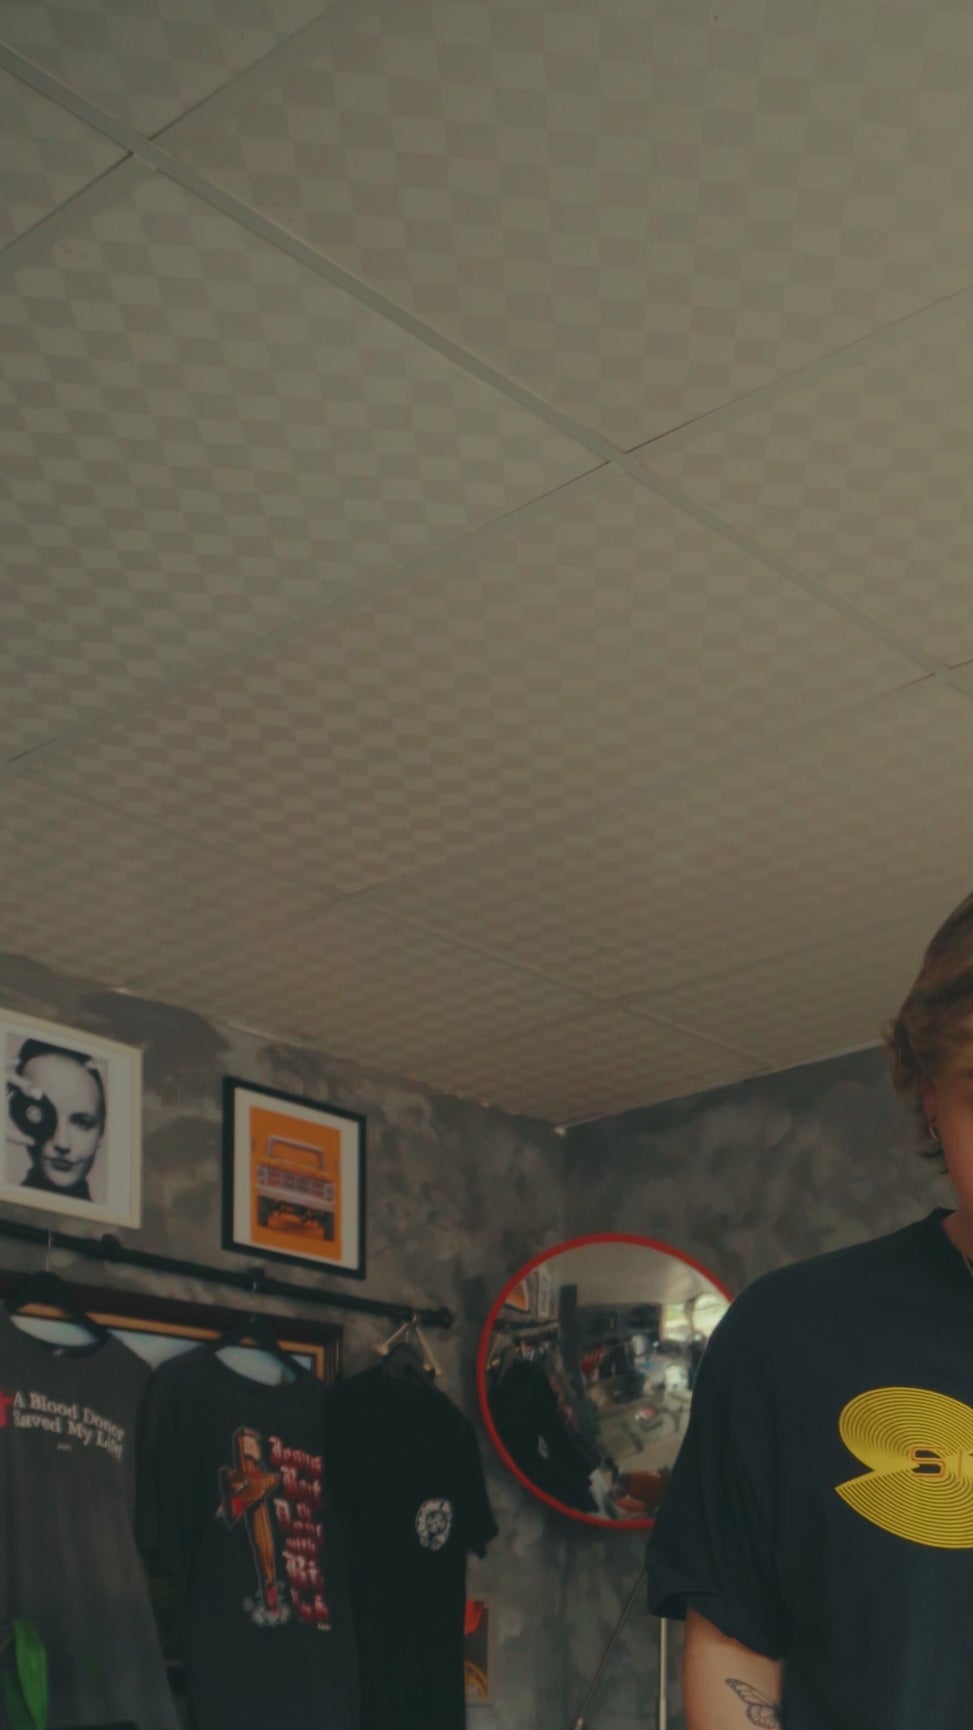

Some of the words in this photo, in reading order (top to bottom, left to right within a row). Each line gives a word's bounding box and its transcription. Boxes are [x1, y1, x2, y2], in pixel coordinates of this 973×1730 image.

[12, 1409, 62, 1434] Saved
[67, 1419, 93, 1446] My
[13, 1390, 26, 1409] A
[29, 1391, 79, 1420] Blood
[83, 1407, 125, 1442] Donor
